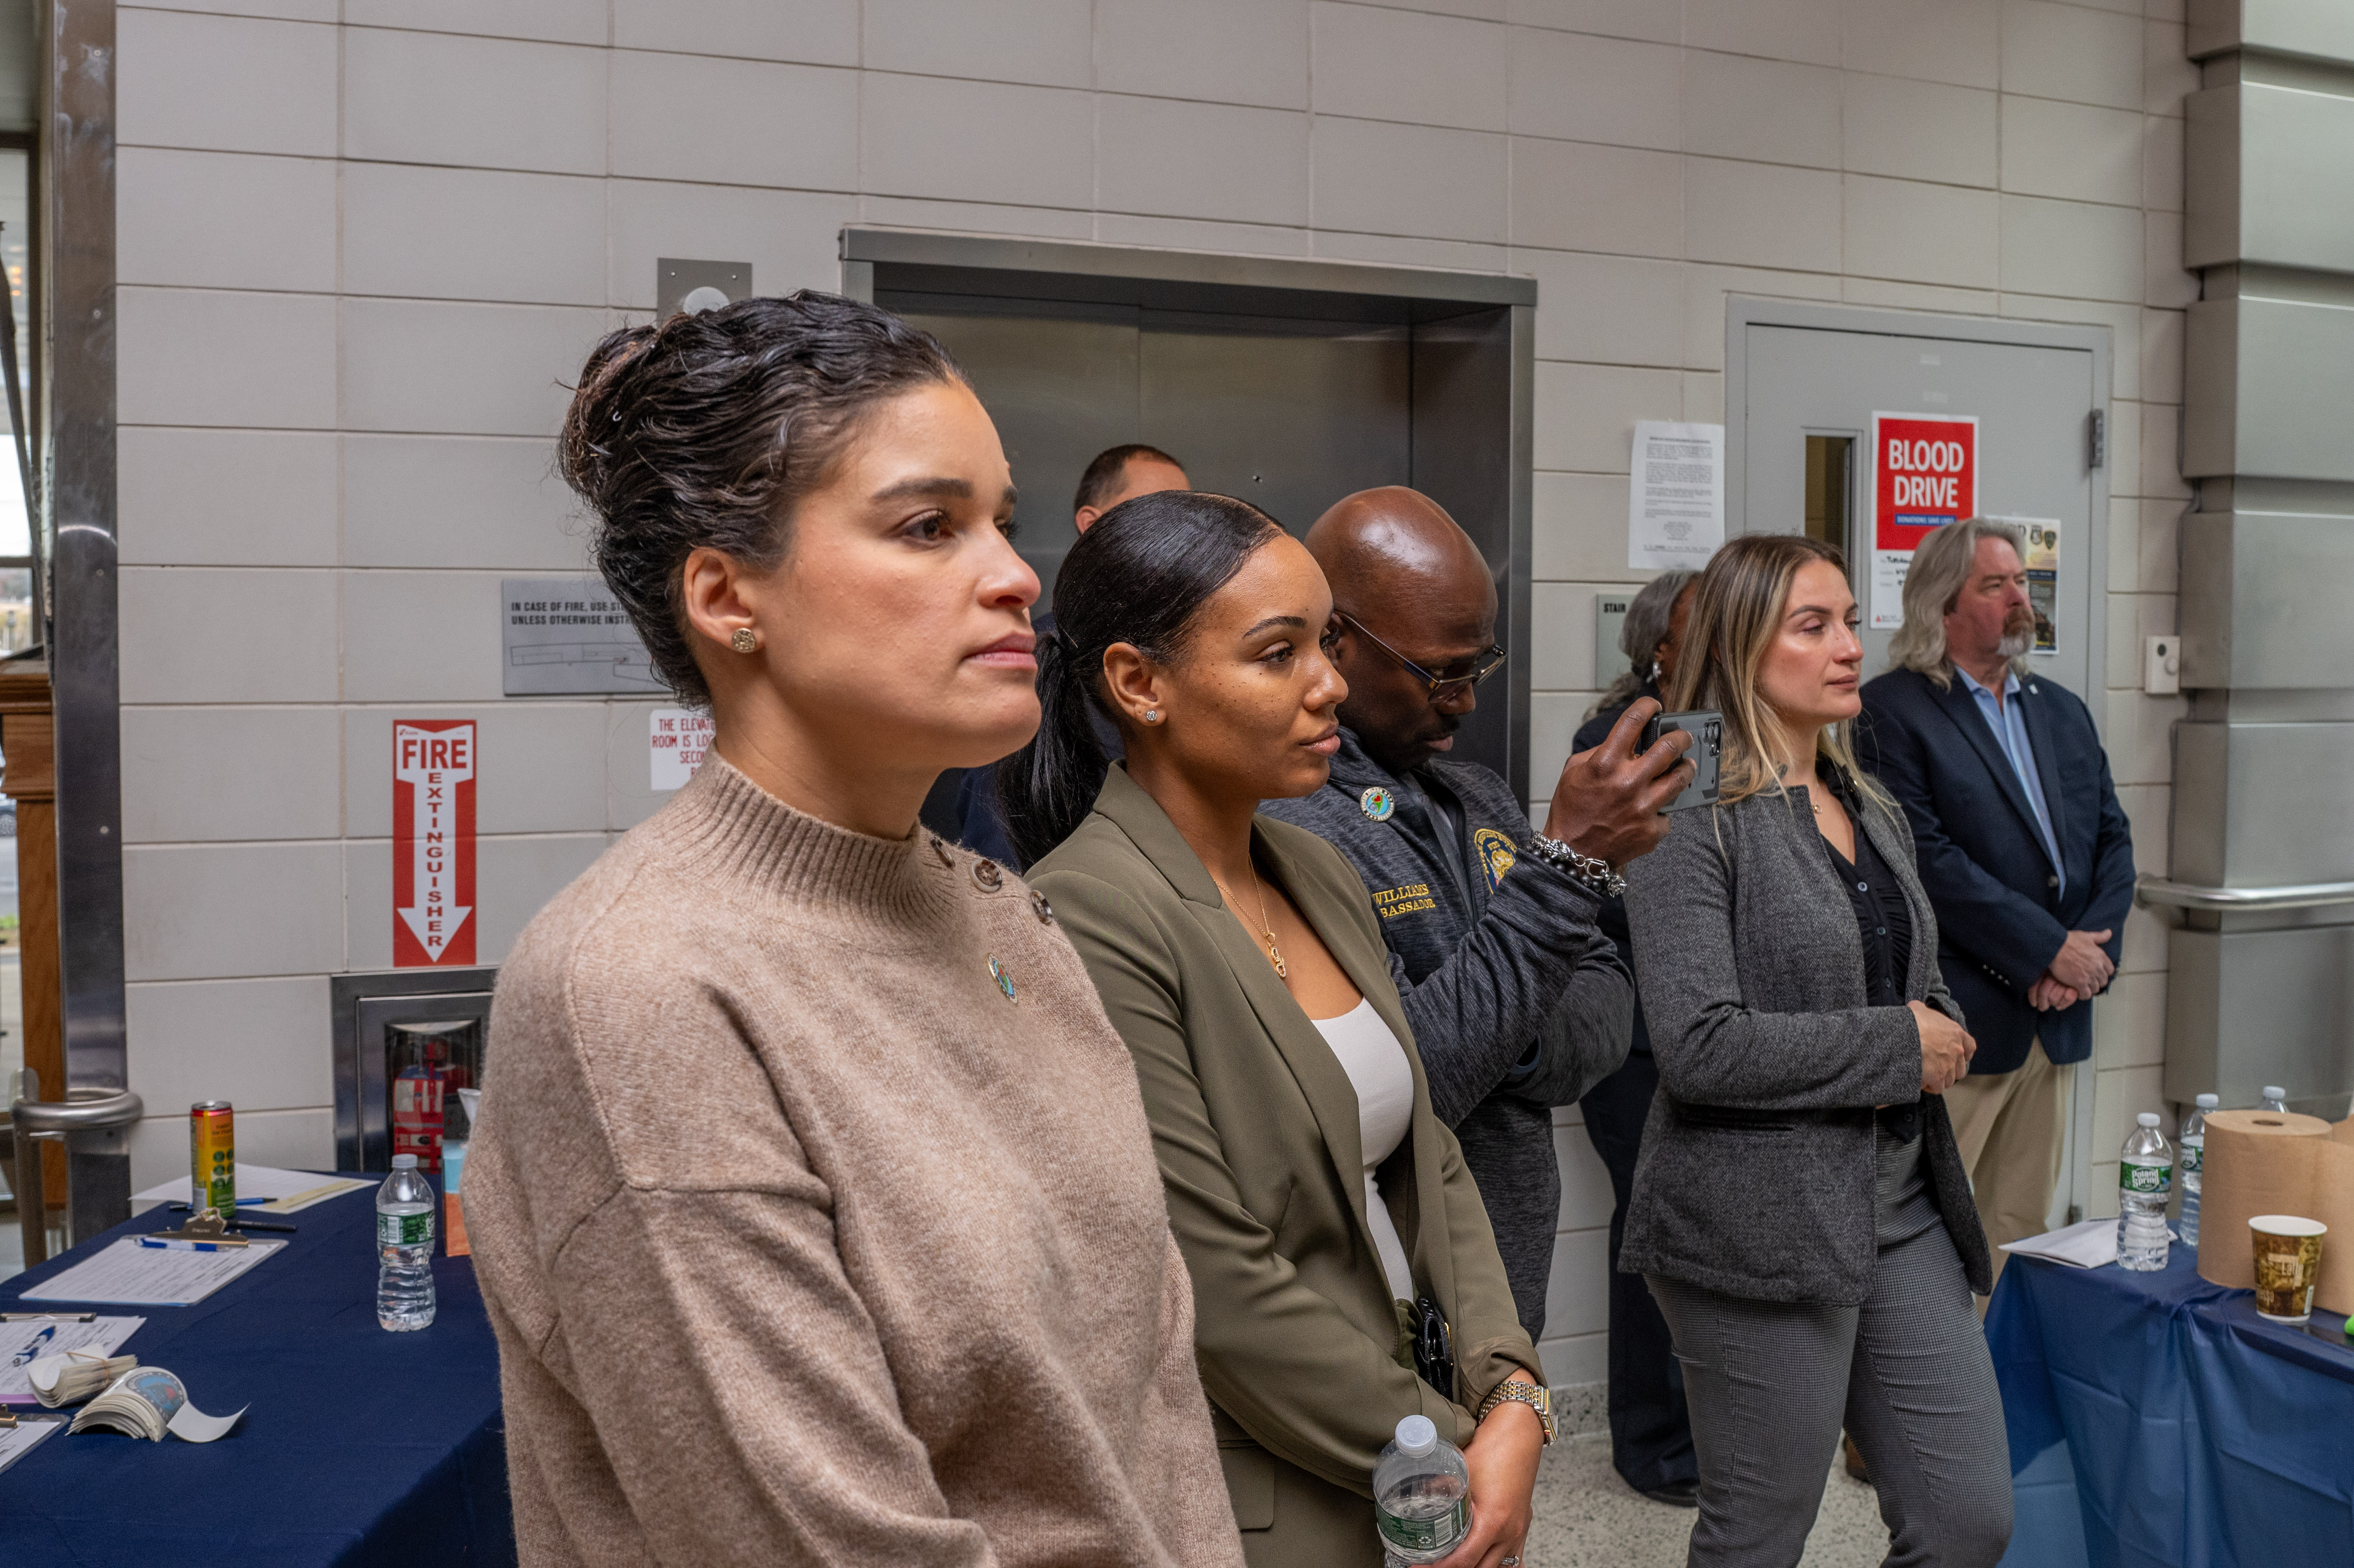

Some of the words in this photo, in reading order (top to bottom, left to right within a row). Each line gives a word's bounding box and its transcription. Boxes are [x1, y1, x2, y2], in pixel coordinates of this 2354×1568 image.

[1889, 438, 1964, 472] BLOOD
[1894, 475, 1958, 508] DRIVE
[511, 602, 521, 611] IN
[524, 602, 547, 611] CASE
[550, 602, 561, 611] OF
[591, 602, 607, 611] USE
[611, 602, 624, 611] ST
[512, 616, 546, 625] UNLESS
[550, 616, 602, 625] OTHERWISE
[659, 719, 675, 731] THE
[681, 718, 714, 731] ELEVAT
[652, 735, 677, 748] ROOM
[683, 735, 691, 747] IS
[403, 739, 467, 769] FIRE
[427, 773, 443, 947] EXTINGUISHER
[1372, 884, 1429, 905] WILLIAMS
[1380, 898, 1435, 918] BASSADOR
[2132, 1168, 2159, 1179] Poland
[2132, 1178, 2160, 1188] Spring
